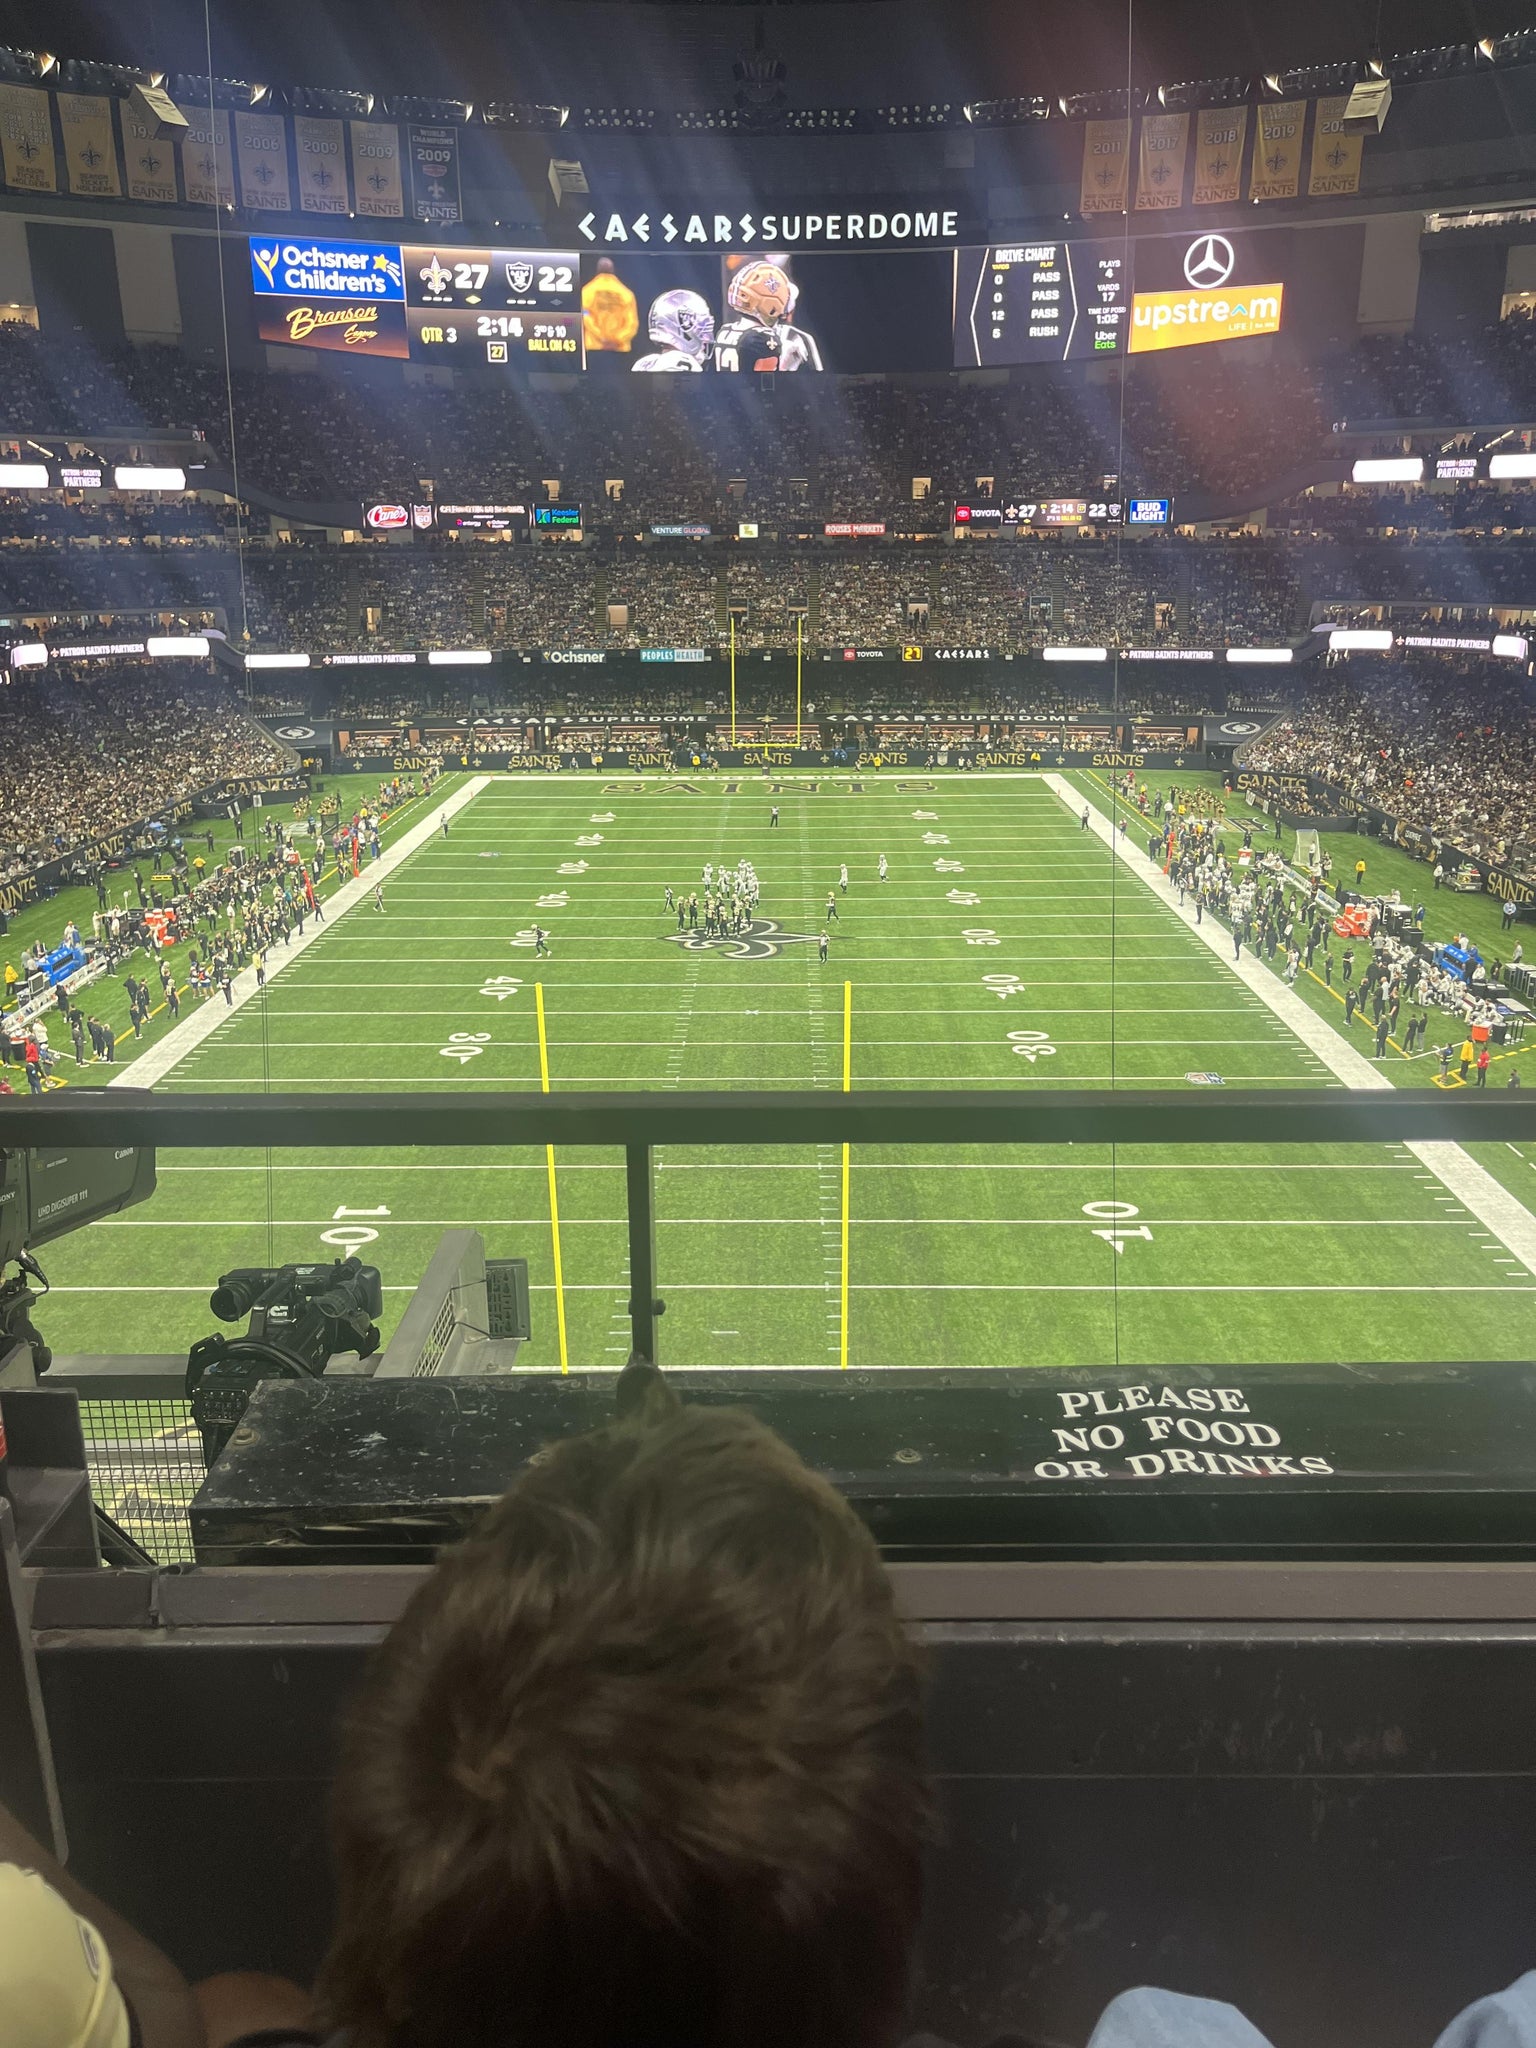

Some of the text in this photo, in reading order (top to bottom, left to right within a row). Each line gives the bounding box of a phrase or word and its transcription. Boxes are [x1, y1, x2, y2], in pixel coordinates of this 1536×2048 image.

[131, 124, 156, 141] 19
[419, 129, 446, 137] WORLD
[1264, 125, 1295, 140] 2019
[1322, 120, 1346, 133] 202
[187, 129, 225, 145] 2000
[244, 135, 280, 150] 2006
[412, 136, 454, 145] CHAMPIONS
[1205, 130, 1238, 145] 2018
[303, 140, 338, 154] 2009
[1093, 142, 1121, 154] 2011
[1149, 137, 1179, 151] 2017
[359, 144, 393, 158] 2009
[417, 149, 451, 162] 2009
[1253, 184, 1295, 197] SAINTS
[1312, 180, 1356, 193] SAINTS
[132, 187, 174, 200] SAINTS
[189, 188, 233, 203] SAINTS
[1195, 188, 1237, 200] SAINTS
[246, 194, 288, 209] SAINTS
[304, 199, 346, 212] SAINTS
[1083, 199, 1122, 211] SAINTS
[1138, 196, 1178, 208] SAINTS
[359, 202, 401, 215] SAINTS
[417, 206, 458, 219] SAINTS
[577, 211, 958, 243] CAESARS SUPERDOME
[283, 246, 369, 270] Ochsner
[995, 247, 1056, 263] DRIVE CHART
[1099, 260, 1121, 268] PLAYS
[454, 263, 490, 290] 27
[538, 266, 573, 292] 22
[994, 272, 1060, 285] 0 PASS
[1105, 268, 1113, 278] 4
[284, 269, 387, 293] Children's
[1097, 283, 1120, 291] YARDS
[993, 290, 1059, 303] 0 PASS
[1102, 292, 1115, 302] 17
[991, 308, 1059, 321] 12 PASS
[1103, 307, 1112, 315] OF
[286, 306, 379, 339] Branson
[1096, 314, 1118, 325] 1:02
[477, 317, 523, 337] 2:14
[554, 325, 567, 338] 10
[1029, 326, 1058, 337] RUSH
[1228, 322, 1247, 332] LIFE
[421, 327, 458, 344] QTR 3
[1095, 331, 1117, 341] Uber
[528, 339, 576, 353] BALL ON 43
[1094, 340, 1117, 350] Eats
[491, 346, 504, 358] 27
[1437, 467, 1475, 479] PARTNERS
[63, 476, 101, 487] PARTNERS
[970, 509, 1001, 518] TOYOTA
[1018, 504, 1037, 518] 27
[1050, 503, 1074, 514] 2:14
[1088, 504, 1107, 518] 22
[1137, 502, 1161, 512] BUD
[1132, 511, 1166, 521] LIGHT
[651, 527, 711, 535] VENTURE GLOBAL
[825, 524, 885, 533] ROUSES MARKETS
[1405, 636, 1490, 649] PATRON SAINTS PARTNERS
[60, 643, 144, 657] PATRON SAINTS PARTNERS
[641, 651, 673, 661] PEOPLES
[856, 650, 884, 658] TOYOTA
[905, 648, 920, 660] 27
[934, 649, 990, 659] CAESARS
[999, 648, 1029, 656] SAINTS
[1129, 650, 1213, 660] PATRON SAINTS PARTNERS
[332, 654, 416, 664] PATRON SAINTS PARTNERS
[550, 651, 605, 663] Ochsner
[455, 715, 708, 725] CAESARS SUPERDOME
[826, 714, 1079, 722] CAESARS SUPERDOME
[511, 755, 561, 769] SAINTS
[628, 753, 670, 766] SAINT
[976, 752, 1026, 766] SAINTS
[1092, 754, 1144, 767] SAINTS
[600, 782, 938, 795] SAINTS
[1487, 871, 1535, 905] SAINTS
[961, 928, 1002, 946] 50
[478, 975, 524, 996] 40
[981, 974, 1026, 995] 40
[439, 1032, 492, 1057] 30
[1006, 1030, 1057, 1056] 30
[114, 1147, 134, 1160] Canon
[0, 1191, 16, 1203] ONY
[37, 1204, 51, 1218] UHD
[51, 1192, 79, 1212] DIGISUPER
[319, 1204, 392, 1246] 10
[1081, 1200, 1154, 1241] 10
[1056, 1385, 1251, 1419] PLEASE
[1052, 1416, 1282, 1453] NO FOOD
[1034, 1448, 1336, 1480] OR DRINKS
